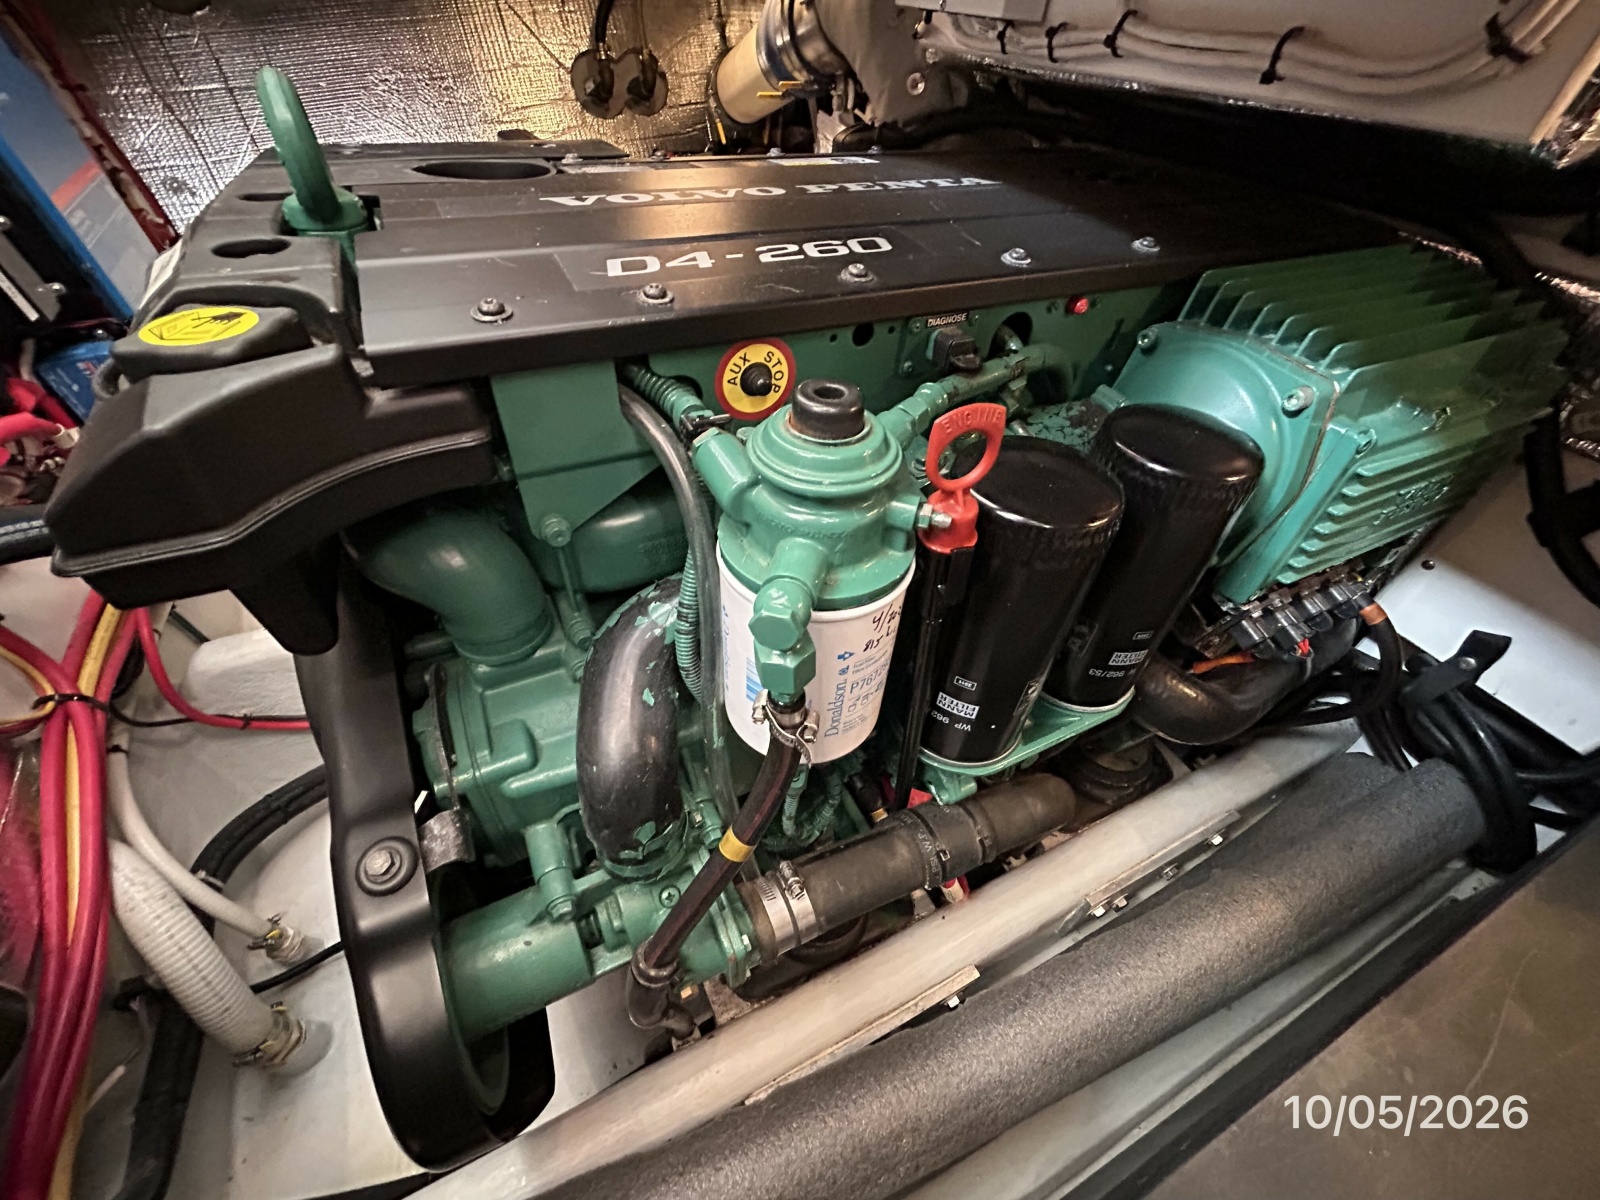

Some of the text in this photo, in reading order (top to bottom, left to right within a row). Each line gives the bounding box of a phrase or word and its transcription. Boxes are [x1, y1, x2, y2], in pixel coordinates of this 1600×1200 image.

[539, 177, 1002, 206] VOLVO PENTA
[606, 237, 893, 277] D4-260
[927, 312, 968, 328] DIAGNOSE
[727, 350, 785, 393] AUX STOP
[941, 406, 1004, 434] ENGINE
[938, 699, 974, 717] MANN
[940, 693, 976, 712] FILTER
[931, 710, 972, 732] WP 962
